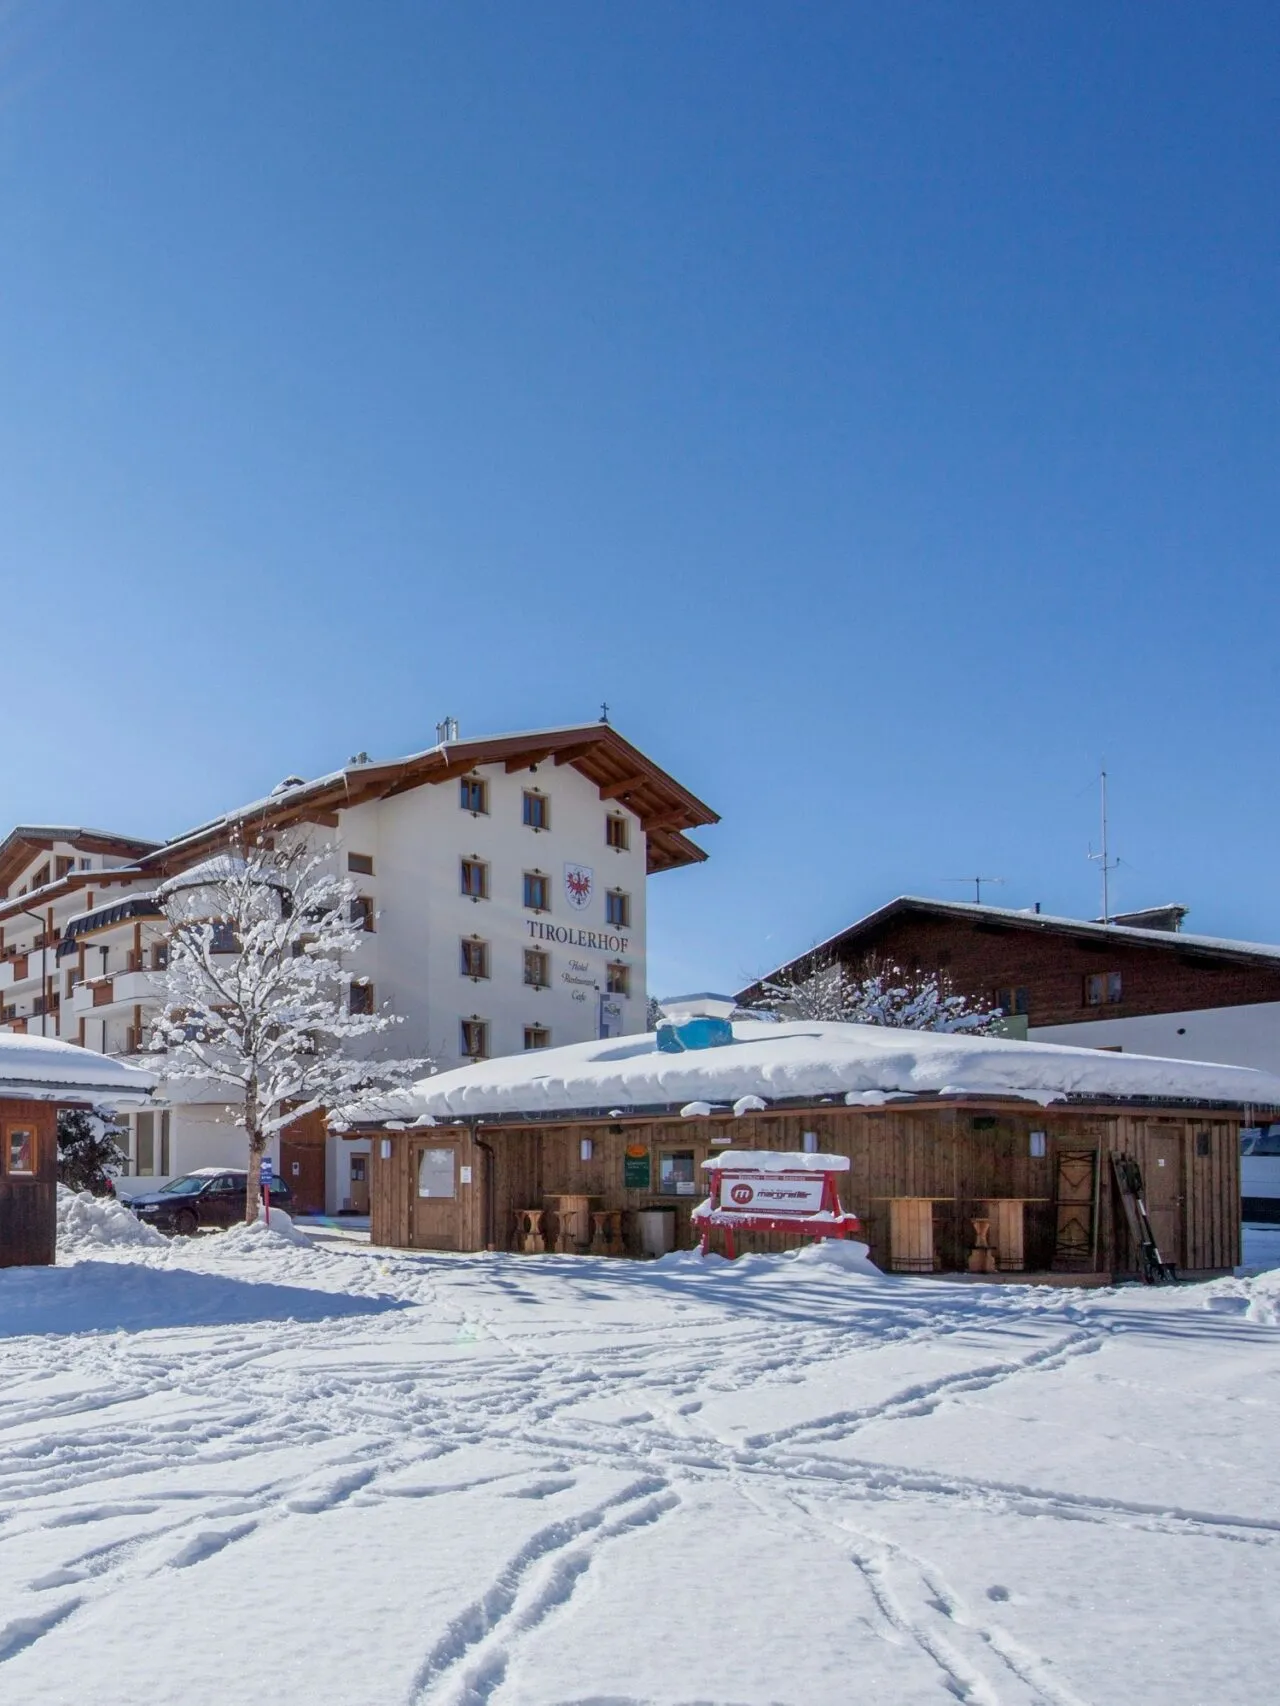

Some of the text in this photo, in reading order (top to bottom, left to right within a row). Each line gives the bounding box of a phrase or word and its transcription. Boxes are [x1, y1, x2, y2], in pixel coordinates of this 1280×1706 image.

[527, 920, 629, 953] TIROLERHOF
[568, 960, 589, 972] Hotel
[561, 972, 596, 986] Restaurant
[757, 1191, 812, 1200] margreiter
